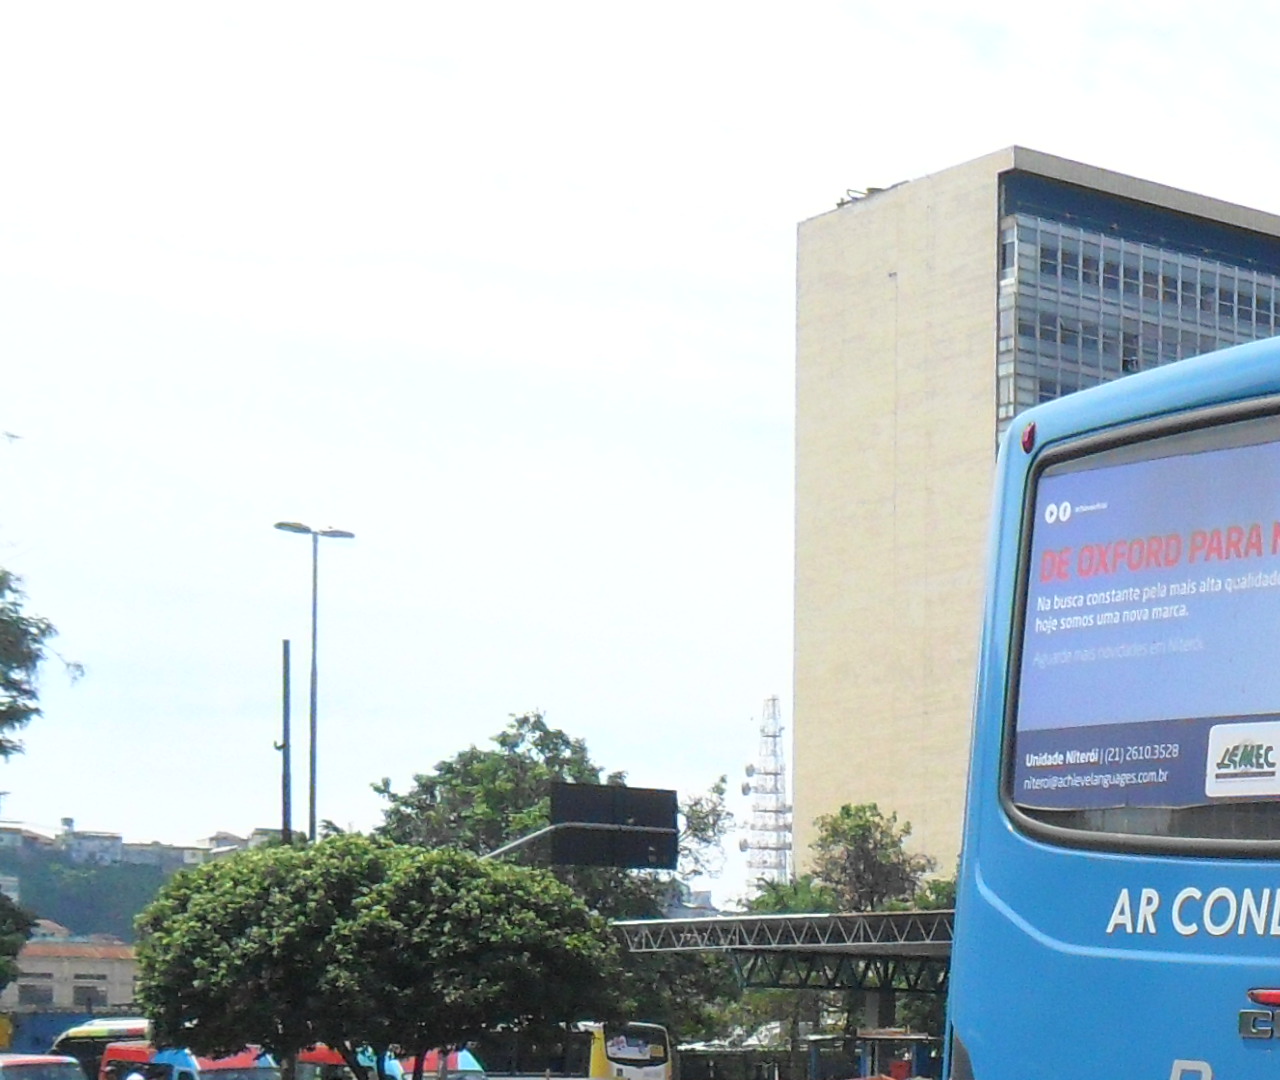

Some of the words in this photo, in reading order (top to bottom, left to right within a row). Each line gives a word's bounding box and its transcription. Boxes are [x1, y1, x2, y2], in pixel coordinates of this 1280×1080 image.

[1040, 547, 1073, 584] DE
[1076, 533, 1183, 579] OXFORD
[1188, 522, 1263, 564] PARA
[1036, 597, 1051, 612] Na
[1053, 594, 1085, 611] busca
[1085, 587, 1140, 606] constante
[1142, 582, 1167, 604] pela
[1169, 579, 1197, 596] mais
[1199, 577, 1222, 593] alta
[1035, 616, 1058, 634] hoje
[1059, 614, 1095, 630] somos
[1096, 611, 1120, 626] uma
[1122, 608, 1149, 623] nova
[1151, 604, 1189, 620] marca.
[1025, 751, 1065, 768] Unidade
[1066, 747, 1099, 765] Niterói
[1104, 746, 1125, 765] (21)
[1125, 743, 1180, 761] 2610.3528
[1105, 887, 1160, 934] AR
